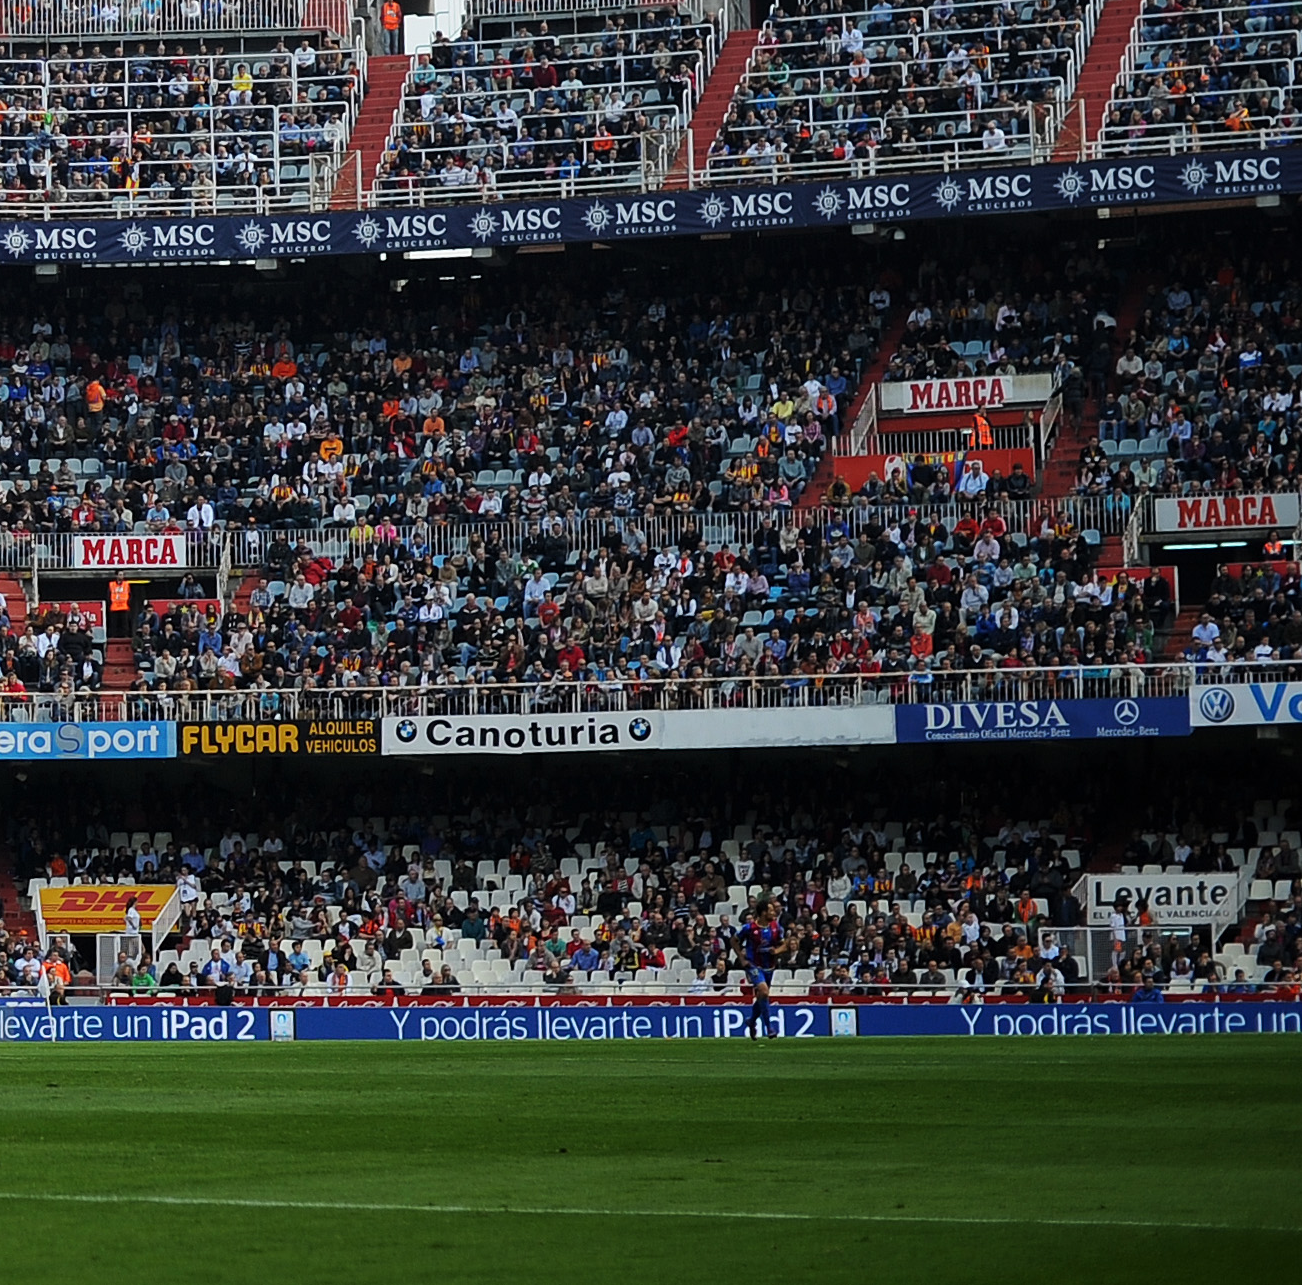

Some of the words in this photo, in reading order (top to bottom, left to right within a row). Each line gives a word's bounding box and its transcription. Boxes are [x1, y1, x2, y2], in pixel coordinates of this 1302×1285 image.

[1089, 165, 1155, 191] MSC
[1214, 157, 1281, 182] MSC
[847, 184, 909, 209] MSC
[968, 174, 1032, 200] MSC
[1091, 192, 1156, 202] CRUCEROS
[1215, 184, 1281, 194] CRUCEROS
[614, 199, 676, 224] MSC
[731, 192, 793, 217] MSC
[848, 210, 910, 220] CRUCEROS
[270, 220, 331, 243] MSC
[385, 214, 447, 237] MSC
[501, 207, 561, 231] MSC
[616, 224, 676, 234] CRUCEROS
[35, 227, 96, 250] MSC
[152, 224, 215, 247] MSC
[153, 248, 215, 257] CRUCEROS
[910, 378, 1005, 410] MARCA
[1178, 496, 1277, 528] MARCA
[82, 539, 177, 565] MARCA
[924, 701, 1069, 729] DIVESA
[182, 724, 298, 754] FLYCAR
[309, 721, 373, 736] ALQUILER
[426, 718, 619, 748] Canoturia
[1097, 725, 1160, 737] Mercedes-Benz
[306, 737, 377, 754] VEHICULOS
[58, 891, 160, 911] DHL
[1095, 880, 1227, 907] Levante
[113, 1014, 153, 1039] un
[161, 1010, 228, 1040] iPad
[236, 1010, 254, 1040] 2
[389, 1010, 410, 1040] Y
[537, 1009, 652, 1039] llevarte
[661, 1015, 701, 1038] un
[796, 1008, 814, 1038] 2
